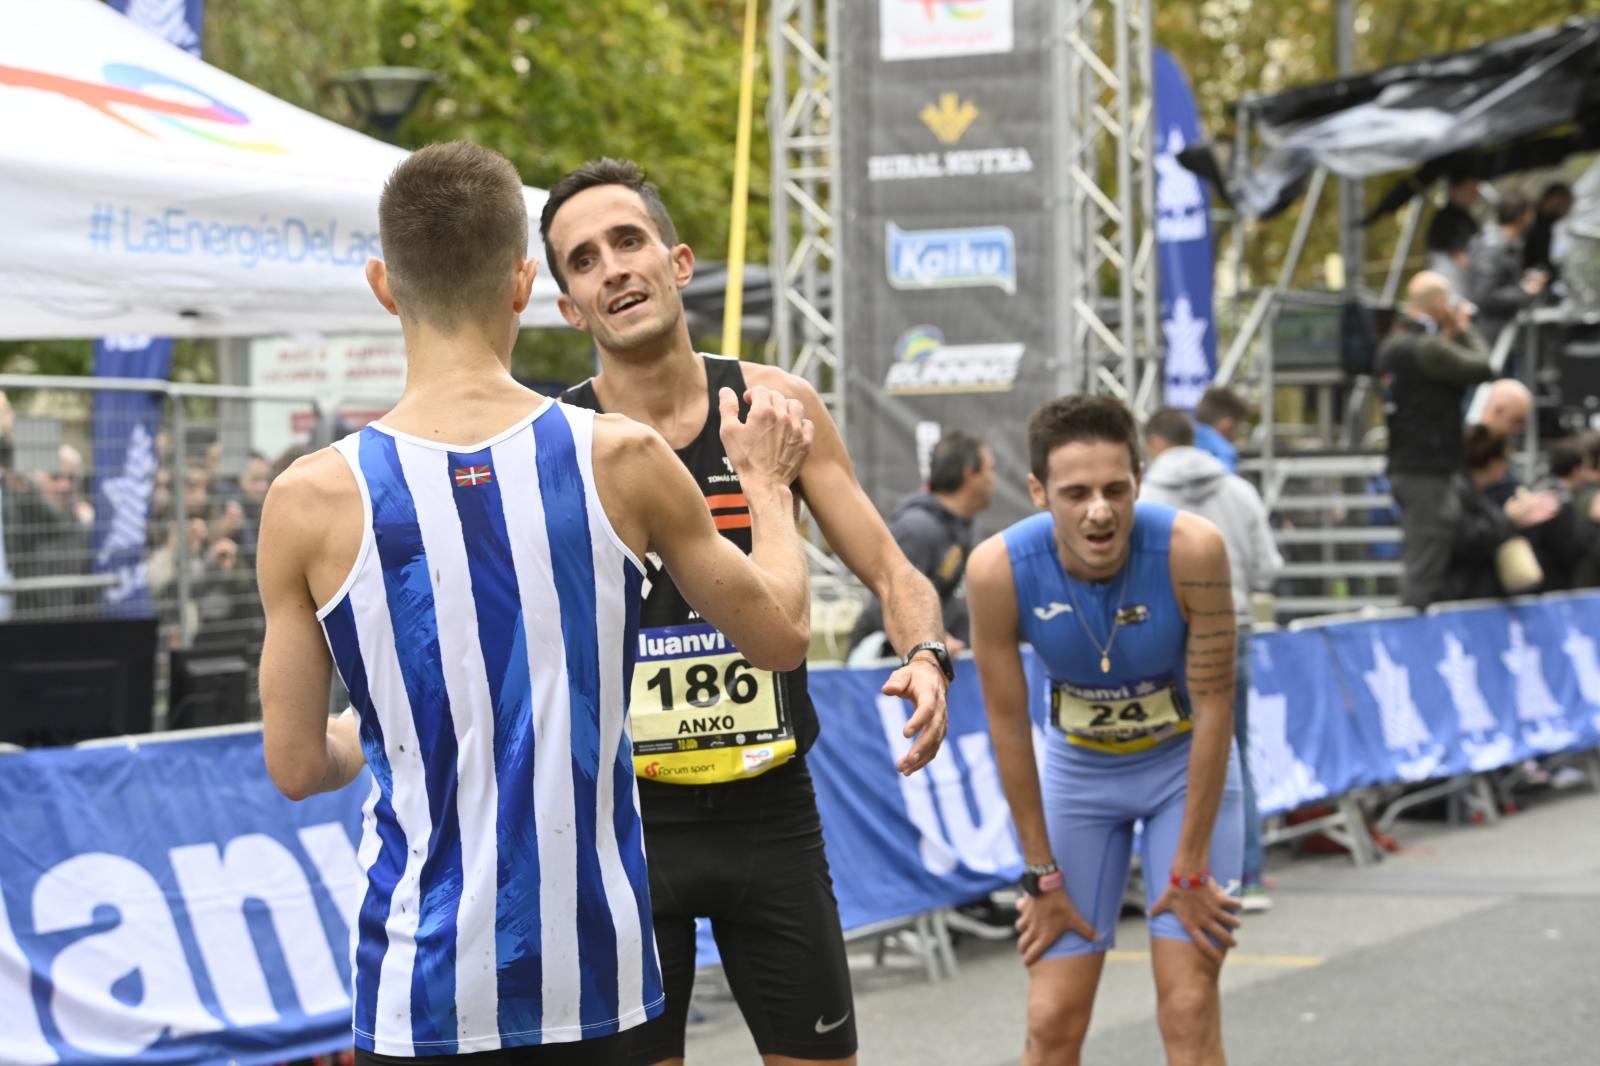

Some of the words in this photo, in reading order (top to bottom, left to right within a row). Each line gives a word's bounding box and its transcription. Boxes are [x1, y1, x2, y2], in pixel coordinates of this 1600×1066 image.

[898, 241, 1002, 280] Kaiku
[639, 631, 725, 656] luanvi
[647, 659, 758, 711] 186
[678, 715, 735, 734] ANXO
[1089, 702, 1148, 726] 24
[658, 765, 689, 777] forum
[690, 763, 715, 774] sport
